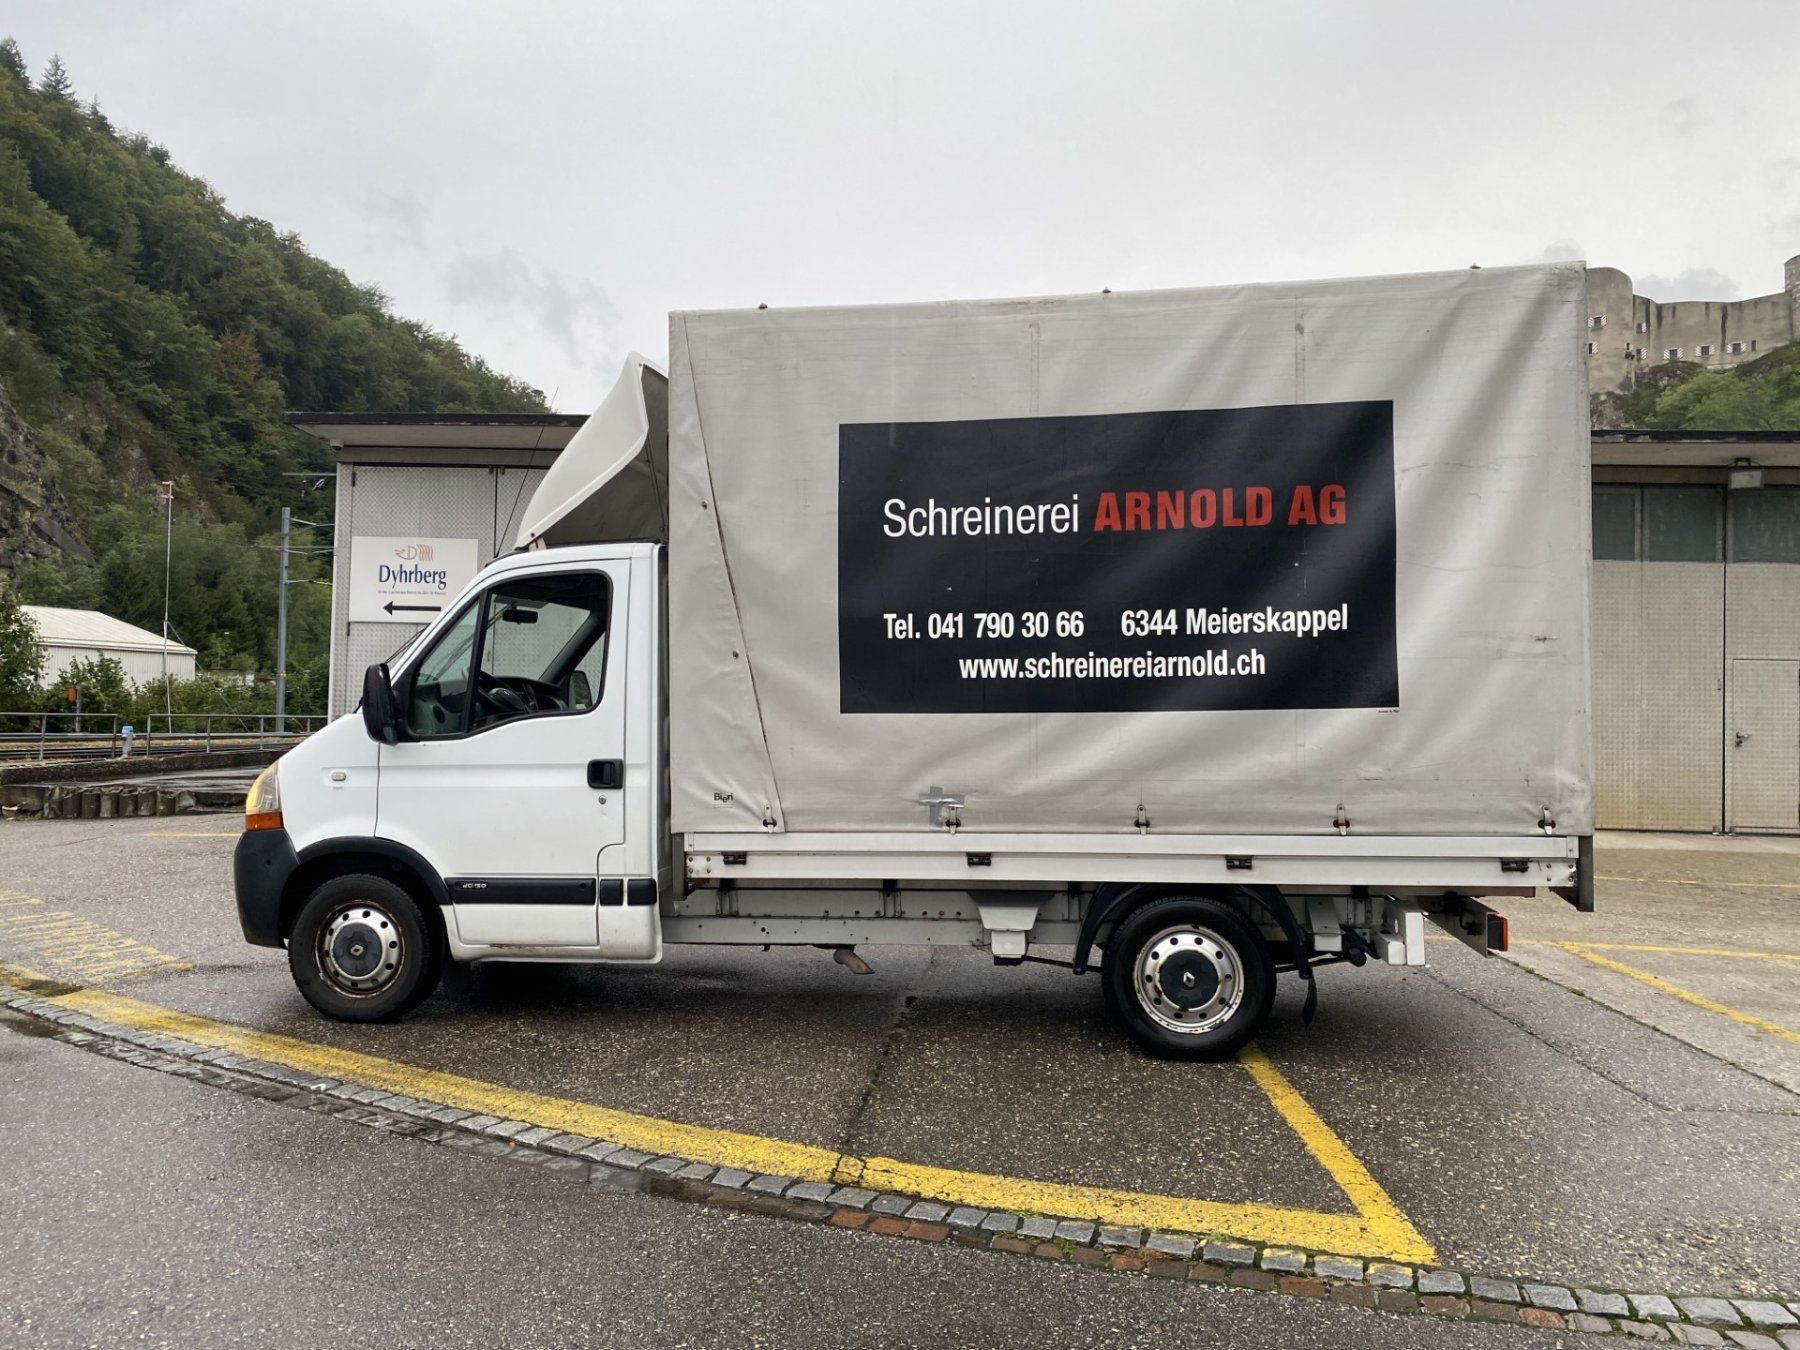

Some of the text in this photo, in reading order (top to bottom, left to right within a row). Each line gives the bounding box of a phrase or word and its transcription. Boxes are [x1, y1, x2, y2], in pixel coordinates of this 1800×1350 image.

[883, 485, 1346, 538] Schreinerei ARNOLD AG
[378, 563, 447, 591] Dyhrberg
[883, 603, 1348, 640] Tel. 041 790 30 66 6344 Meierskappel
[958, 648, 1266, 679] www.schreinereiarnold.ch
